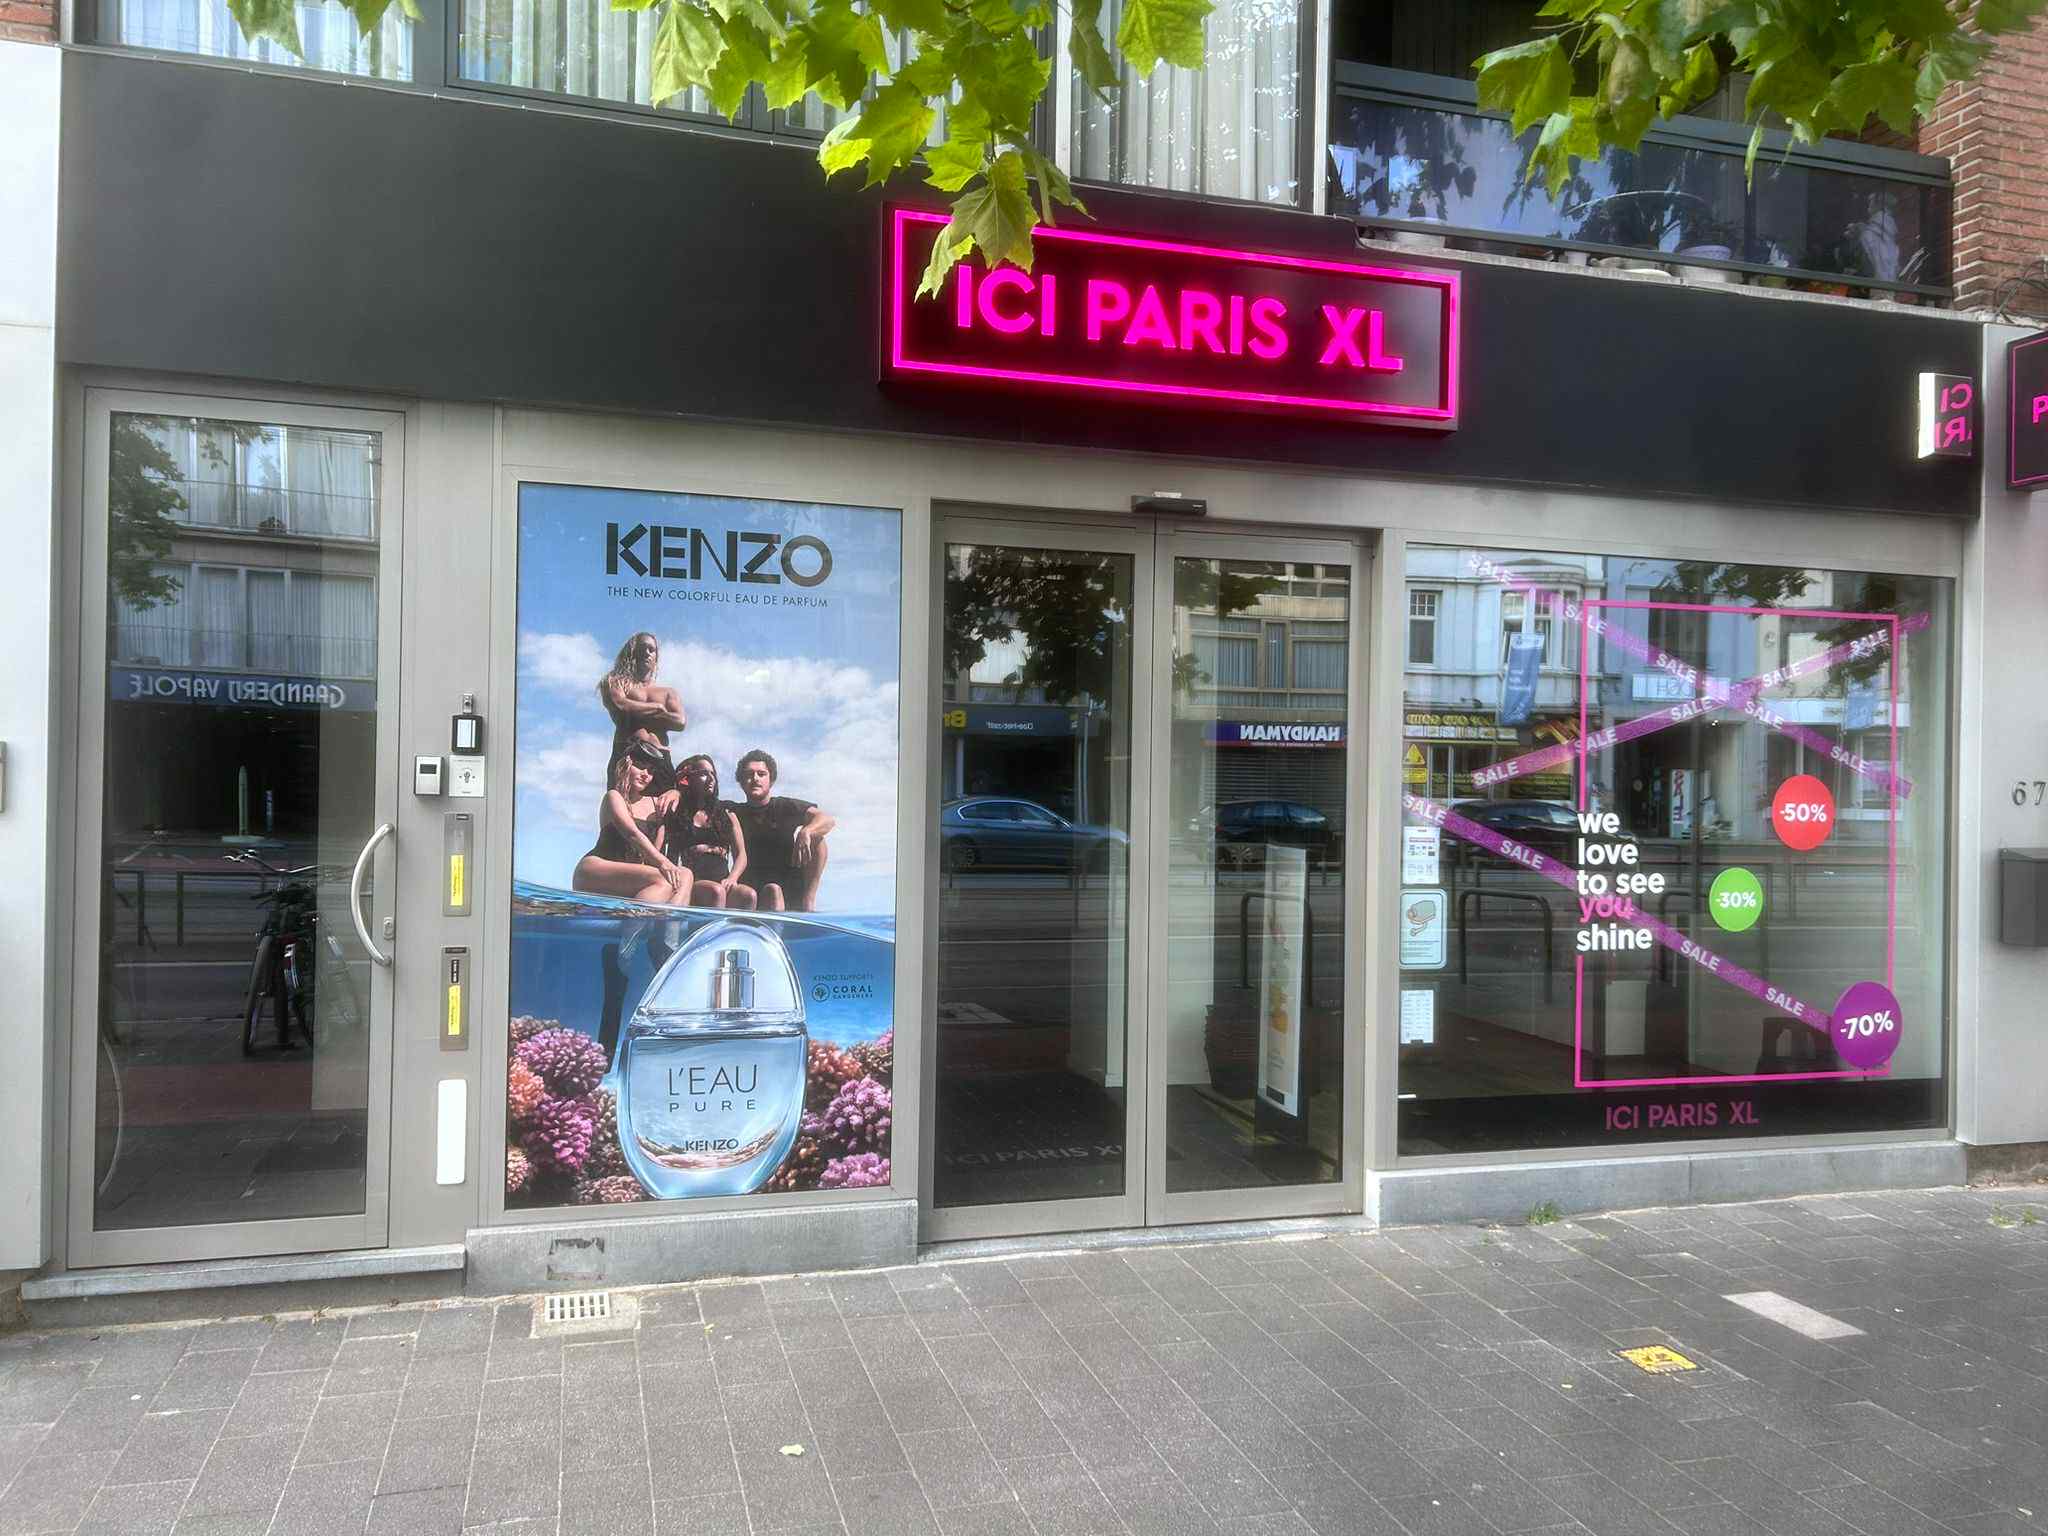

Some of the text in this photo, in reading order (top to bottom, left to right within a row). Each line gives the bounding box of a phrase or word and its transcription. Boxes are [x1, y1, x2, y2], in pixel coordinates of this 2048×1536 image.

[957, 264, 1403, 372] ICI PARIS XL
[606, 522, 833, 587] KENZO
[607, 586, 828, 608] THE NEW COLORFUL EAU DE PARFUM
[1565, 602, 1608, 634] SALE
[1849, 628, 1889, 653] SALE
[1655, 653, 1698, 684] SALE
[1762, 661, 1803, 687] SALE
[1671, 696, 1713, 721] SALE
[1744, 701, 1785, 729] SALE
[1575, 728, 1618, 753] SALE
[1830, 745, 1869, 774] SALE
[1473, 761, 1519, 787] SALE
[1402, 792, 1448, 826] SALE
[1779, 803, 1827, 823] -50%
[1577, 813, 1620, 834] we
[1500, 840, 1544, 870] SALE
[1578, 838, 1639, 864] love
[1577, 870, 1608, 896] to
[1615, 873, 1665, 894] see
[1579, 895, 1635, 923] you
[1715, 891, 1757, 909] -30%
[1576, 923, 1653, 951] shine
[1680, 940, 1721, 972] SALE
[832, 984, 873, 994] CORAL
[1765, 987, 1805, 1016] SALE
[1840, 1010, 1894, 1040] -70%
[668, 1063, 758, 1096] L'EAU
[669, 1099, 757, 1113] PURE
[1605, 1101, 1760, 1131] ICI PARIS XL
[685, 1137, 739, 1152] KENZO
[995, 1146, 1090, 1162] PARIS
